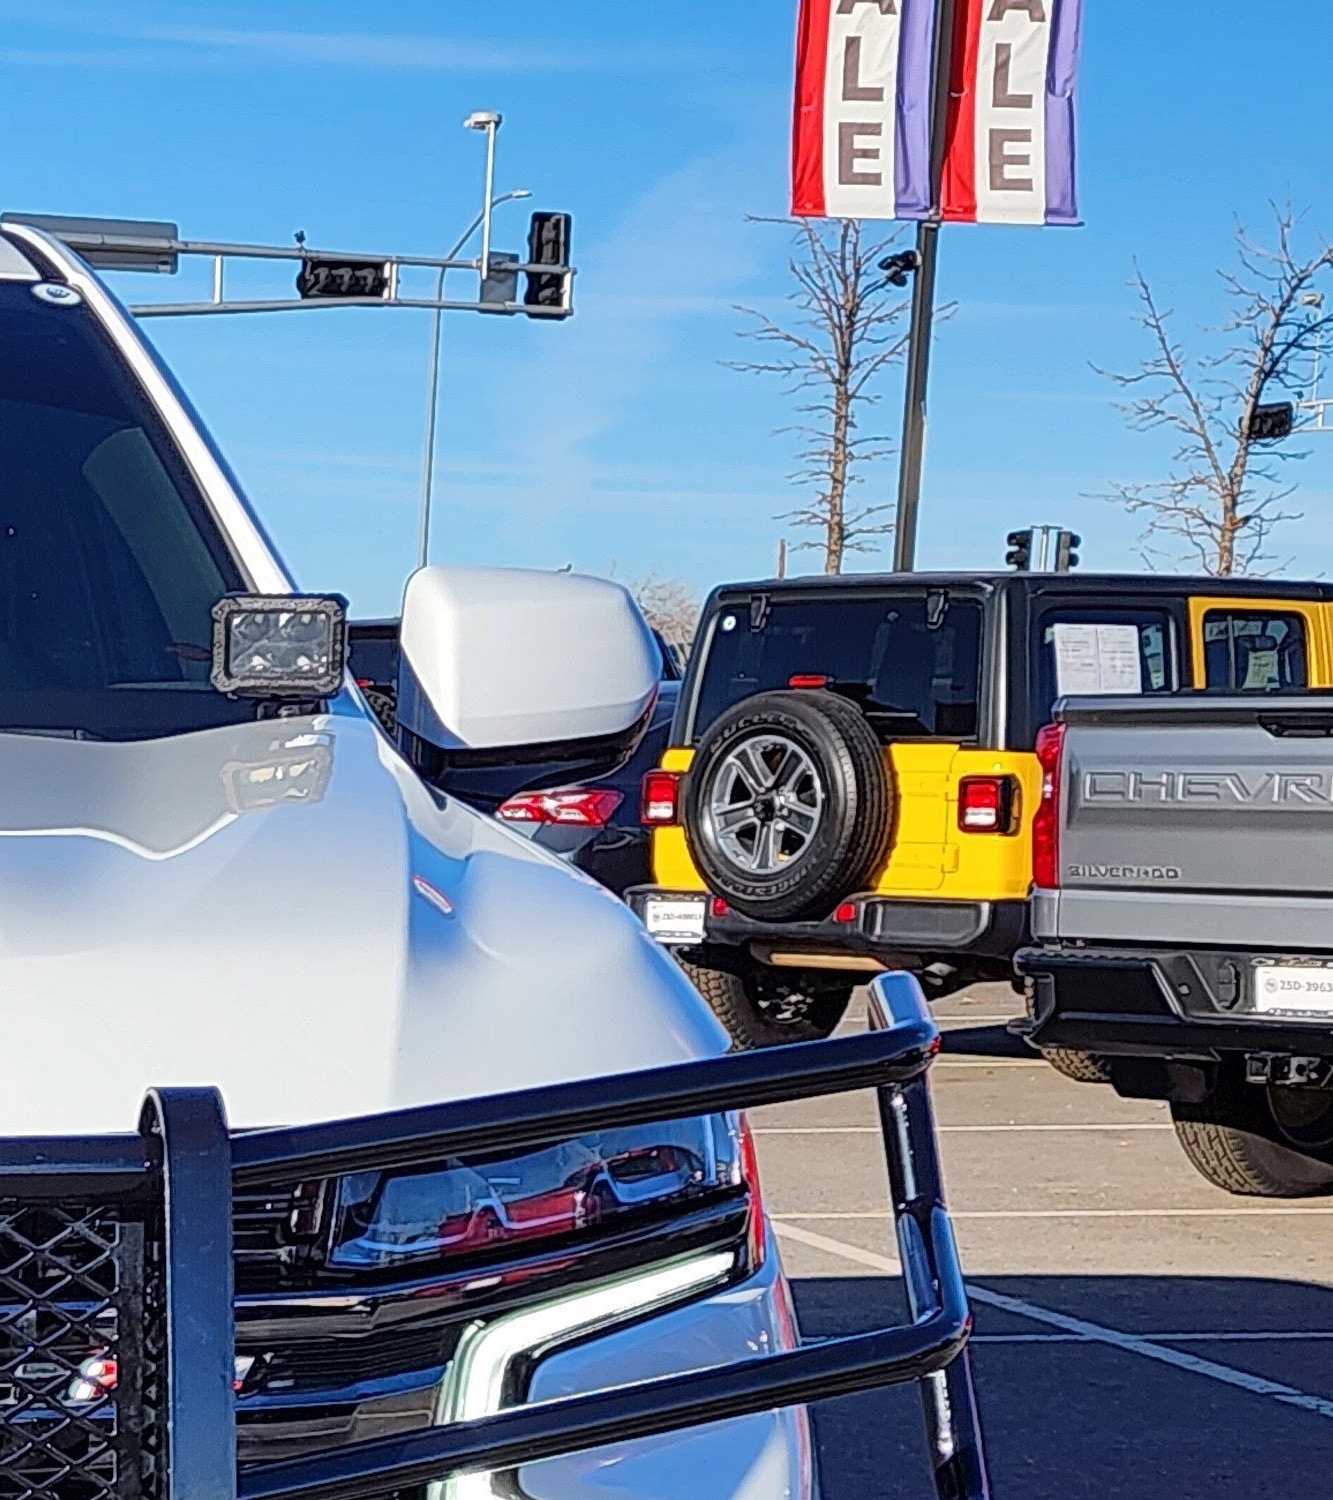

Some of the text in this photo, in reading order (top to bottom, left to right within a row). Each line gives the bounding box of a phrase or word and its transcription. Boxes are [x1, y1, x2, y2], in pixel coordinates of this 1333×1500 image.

[836, 0, 897, 185] LE
[1084, 771, 1333, 802] CHEVR
[1068, 865, 1180, 880] SILVERADO
